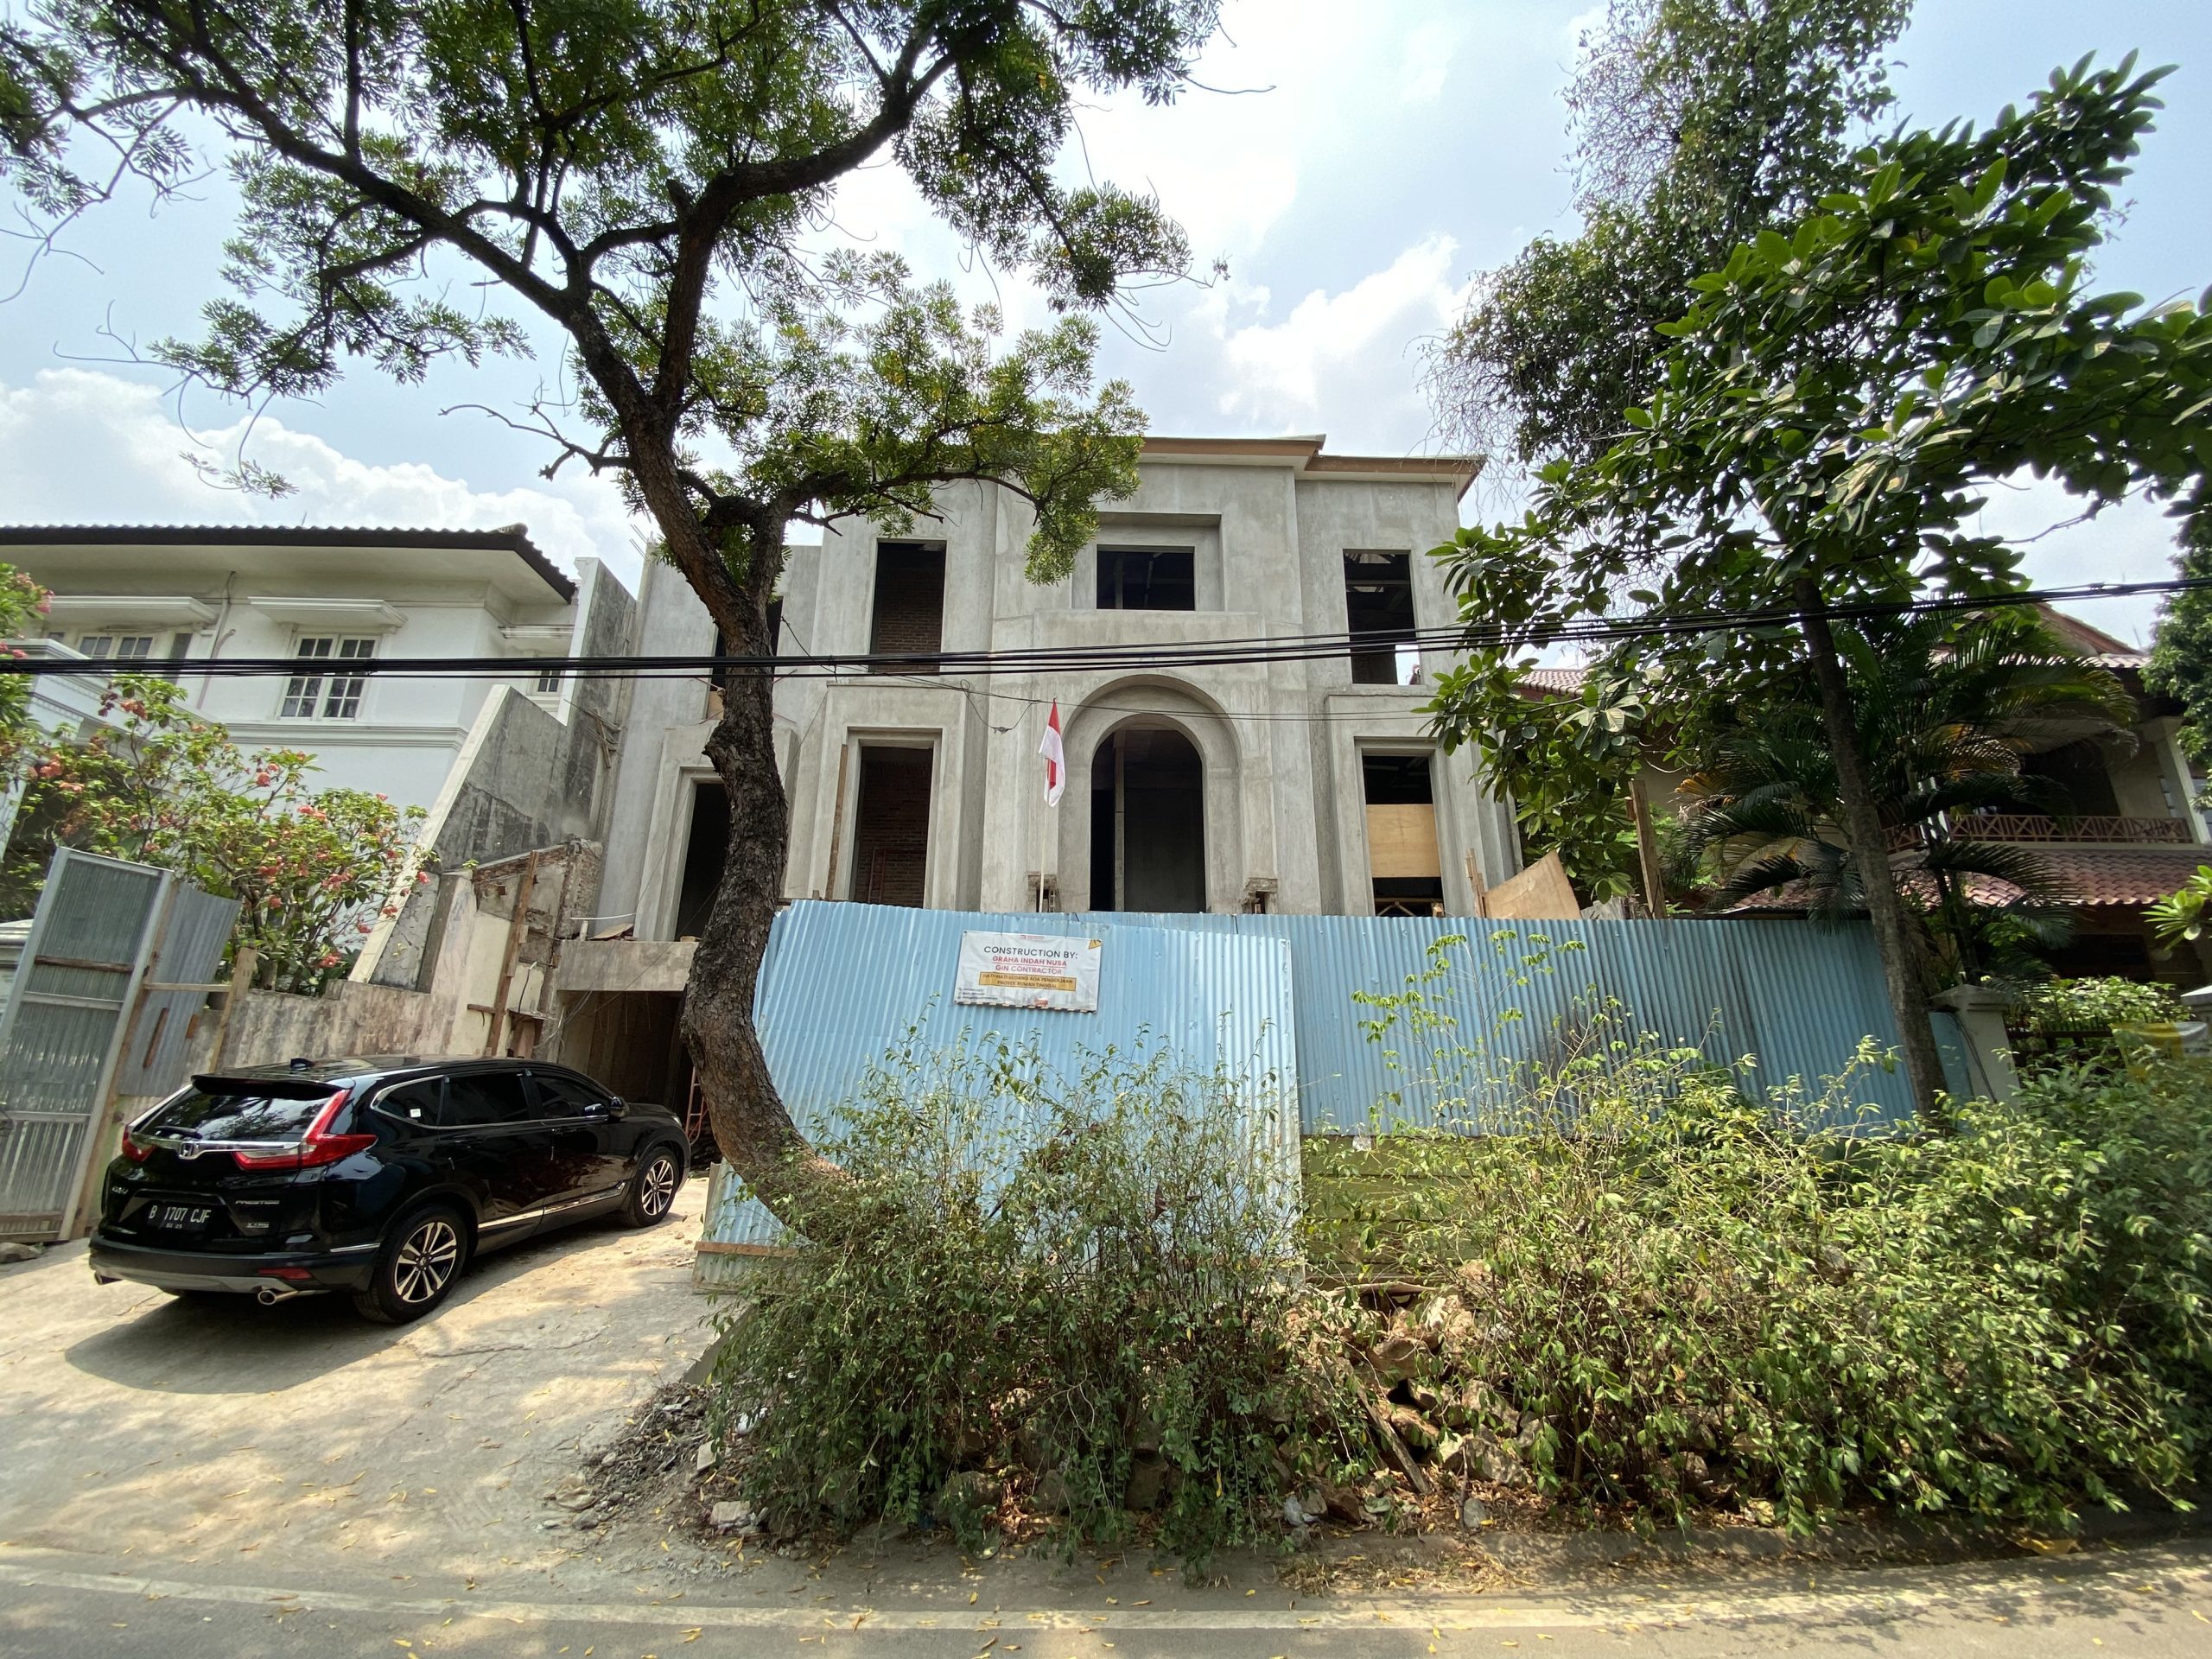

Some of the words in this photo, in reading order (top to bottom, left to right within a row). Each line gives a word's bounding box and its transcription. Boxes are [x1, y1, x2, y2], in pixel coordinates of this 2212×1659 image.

[983, 946, 1060, 958] CONSTRUCTION
[1011, 965, 1062, 974] CONTRACTOR
[149, 1205, 158, 1219] B
[164, 1206, 188, 1222] 1707
[190, 1209, 212, 1224] CJF
